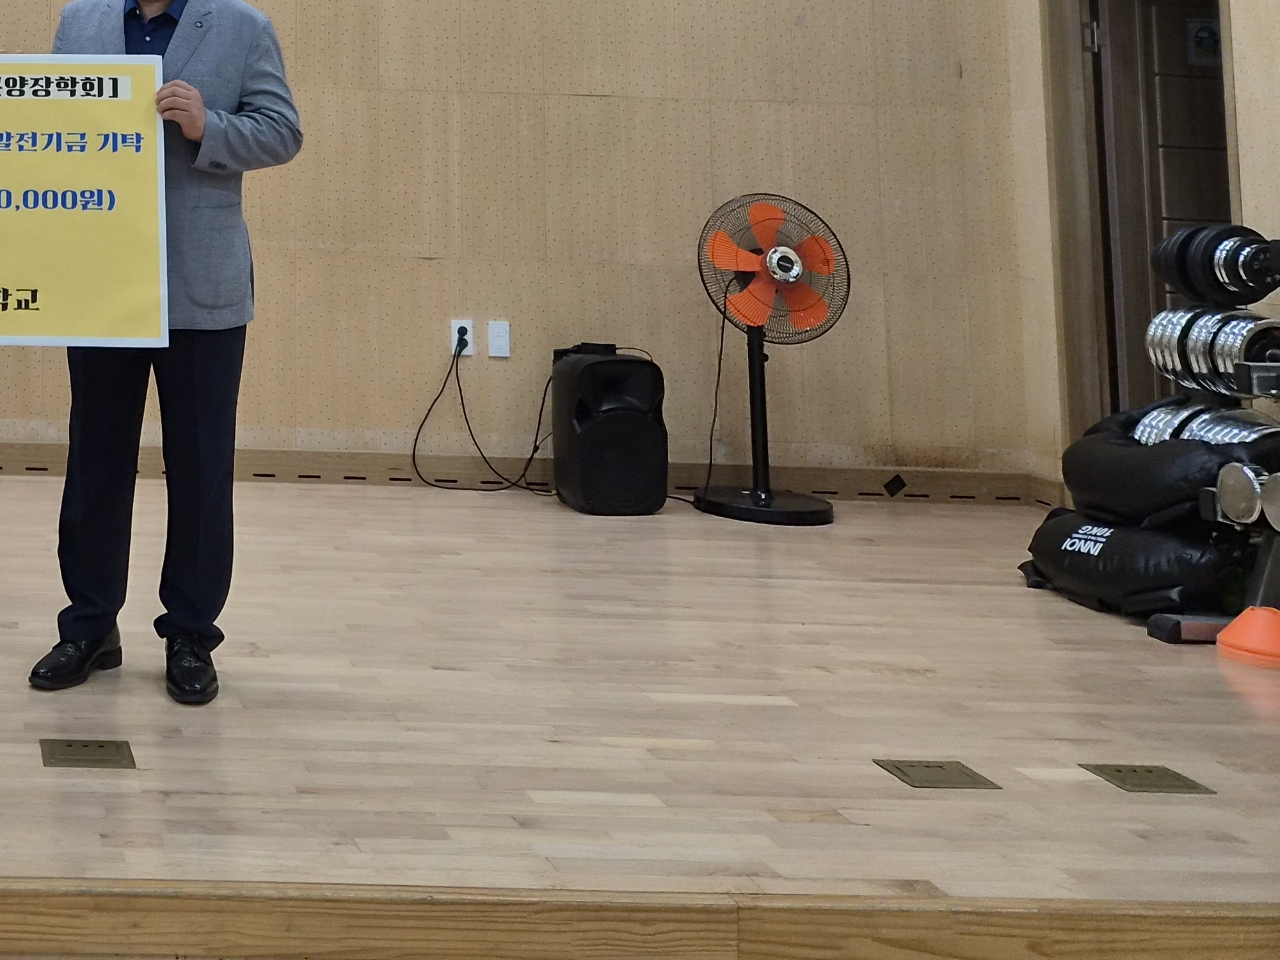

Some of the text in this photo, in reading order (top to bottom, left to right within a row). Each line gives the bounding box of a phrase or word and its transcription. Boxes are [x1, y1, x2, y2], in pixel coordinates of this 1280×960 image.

[96, 131, 145, 154] 기탁
[1078, 525, 1114, 538] 10KG
[1061, 537, 1104, 556] INNOI
